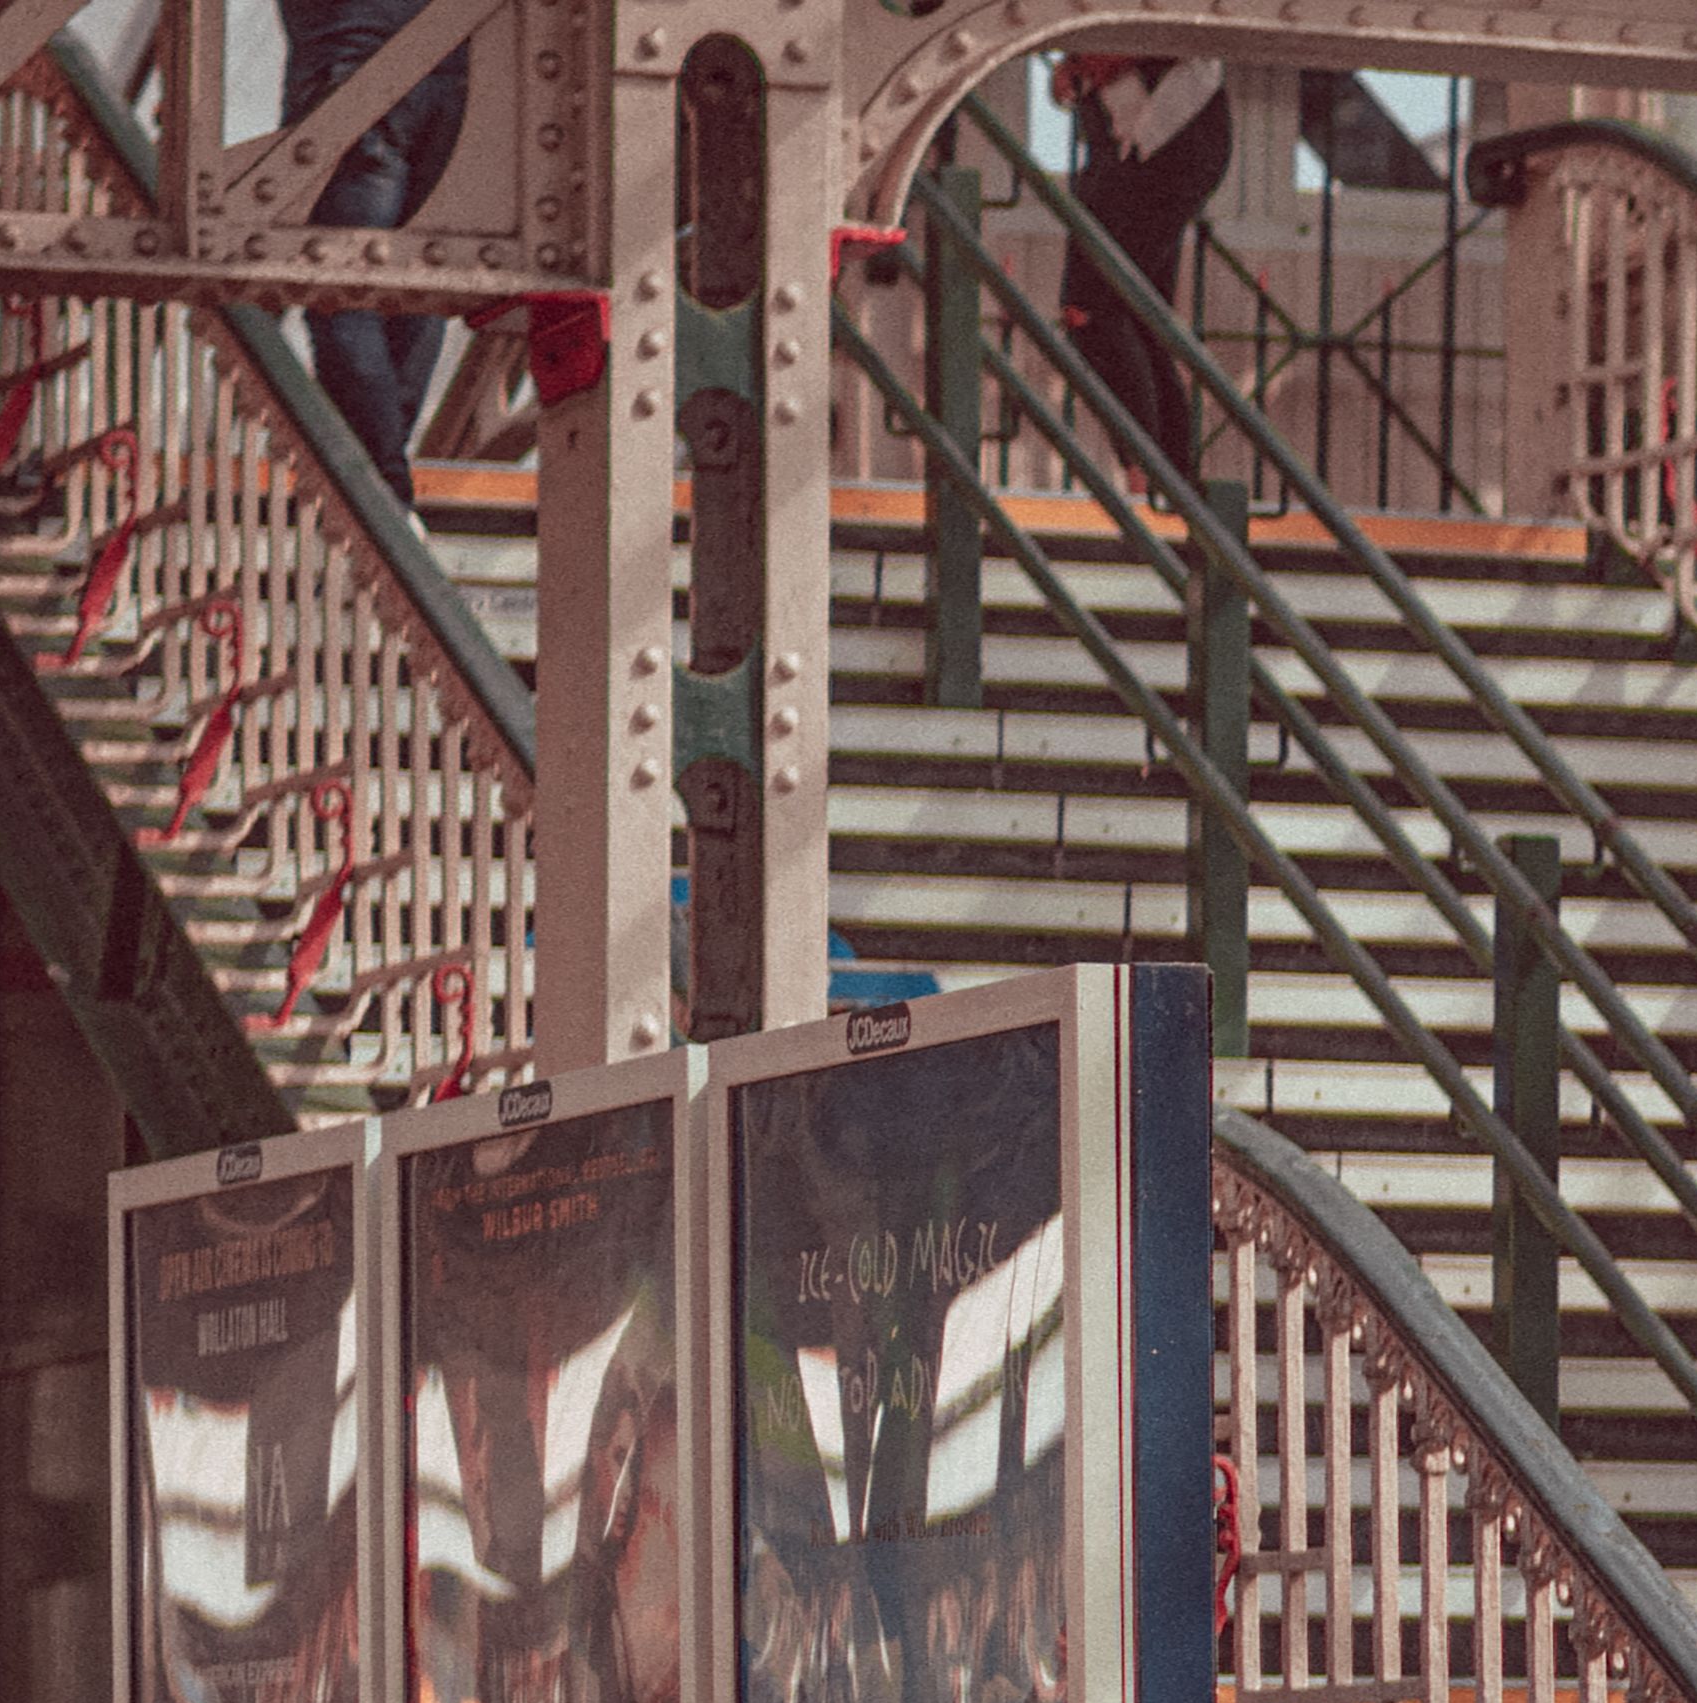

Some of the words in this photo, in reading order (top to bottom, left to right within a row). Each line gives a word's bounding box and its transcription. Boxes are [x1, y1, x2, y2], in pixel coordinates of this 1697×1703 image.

[849, 1014, 908, 1051] JCDecaux
[502, 1092, 551, 1124] JCDecaux
[482, 1201, 544, 1242] WILBUR
[549, 1192, 599, 1230] SMITH
[159, 1250, 191, 1301] OPEN
[192, 1246, 214, 1292] AIR
[215, 1236, 258, 1289] CINEMA
[274, 1223, 316, 1275] COMING
[799, 1228, 898, 1304] ICE-COLD
[909, 1216, 1000, 1296] MAGIC
[198, 1301, 255, 1358] WOLLATON
[257, 1296, 289, 1346] HALL
